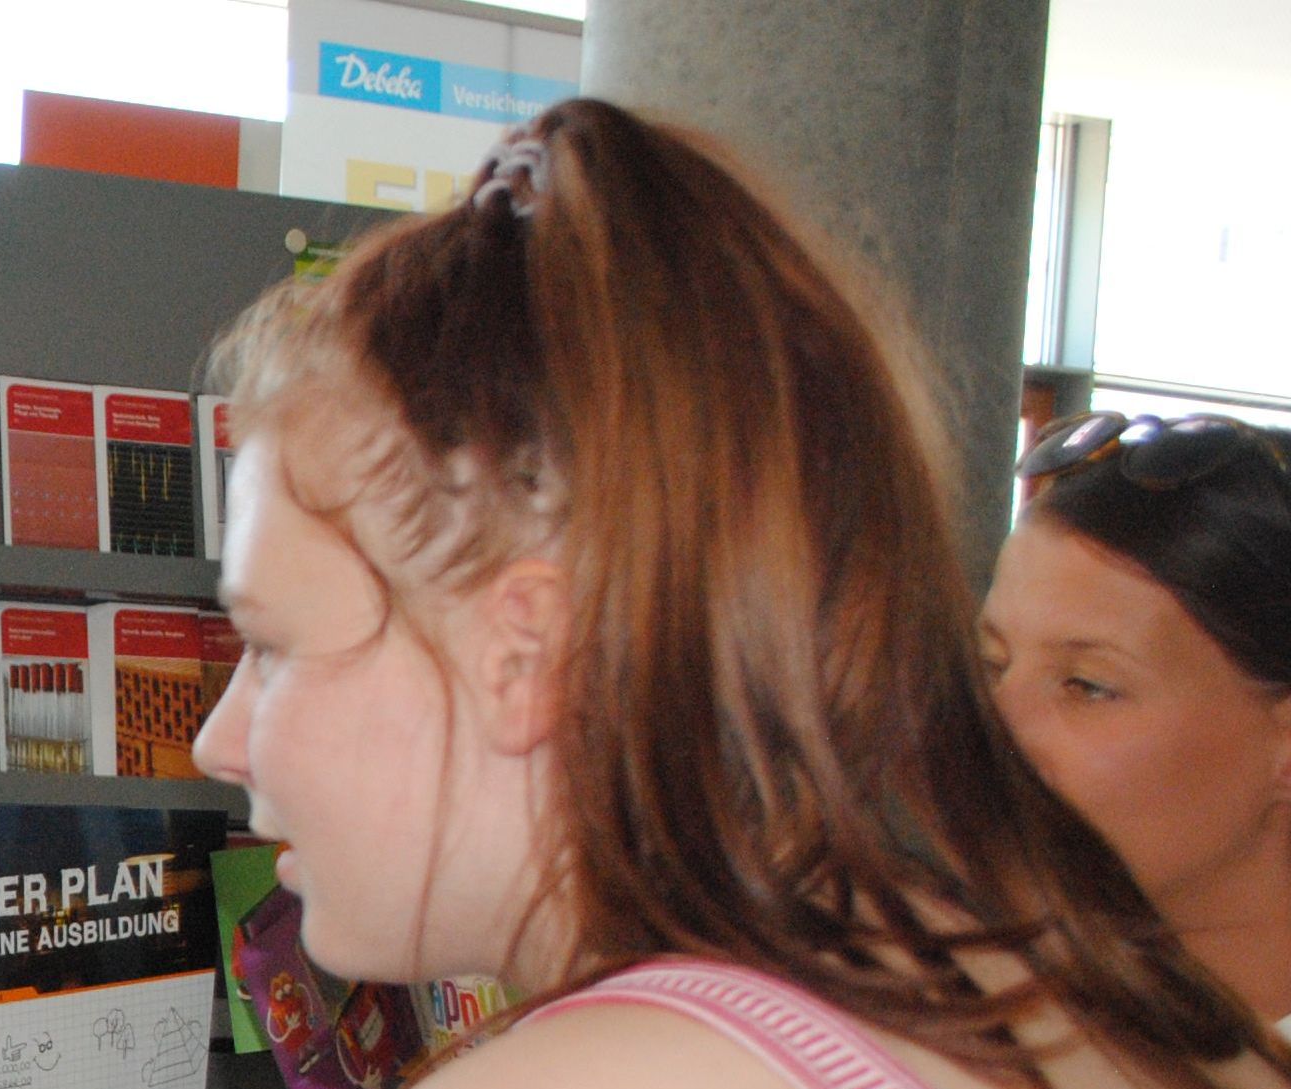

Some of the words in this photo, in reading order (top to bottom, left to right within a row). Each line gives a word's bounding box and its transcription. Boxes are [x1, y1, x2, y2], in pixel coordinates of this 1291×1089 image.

[335, 53, 423, 100] Debeka
[60, 856, 164, 911] PLAN
[36, 910, 180, 952] AUSBILDUNG
